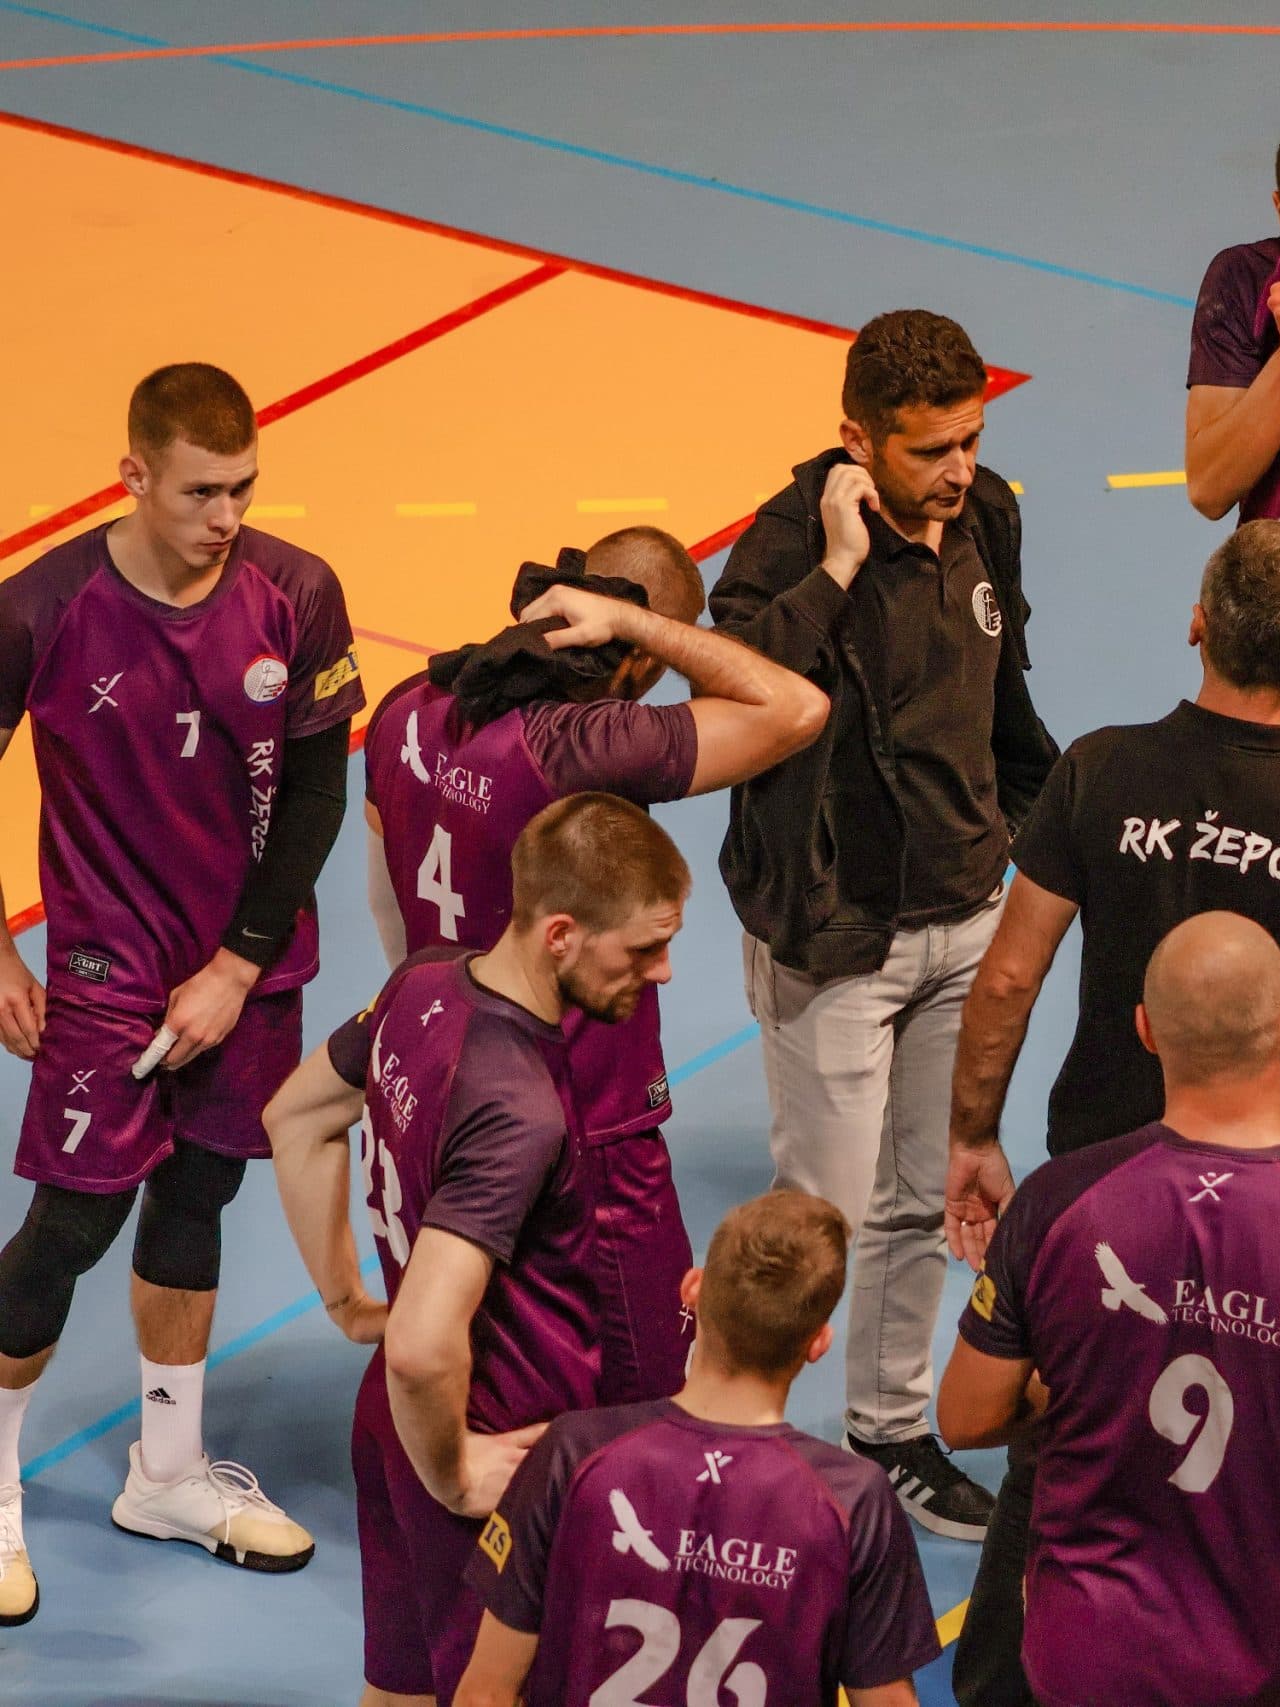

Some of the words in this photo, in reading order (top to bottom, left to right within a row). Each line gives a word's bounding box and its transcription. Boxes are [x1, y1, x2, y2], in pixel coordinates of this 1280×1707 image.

[176, 710, 200, 758] 7
[247, 738, 275, 777] RK
[1119, 817, 1182, 862] RK
[417, 824, 466, 941] 4
[61, 1108, 92, 1154] 7
[1149, 1353, 1235, 1494] 9
[676, 1529, 798, 1576] EAGLE
[588, 1598, 768, 1707] 26
